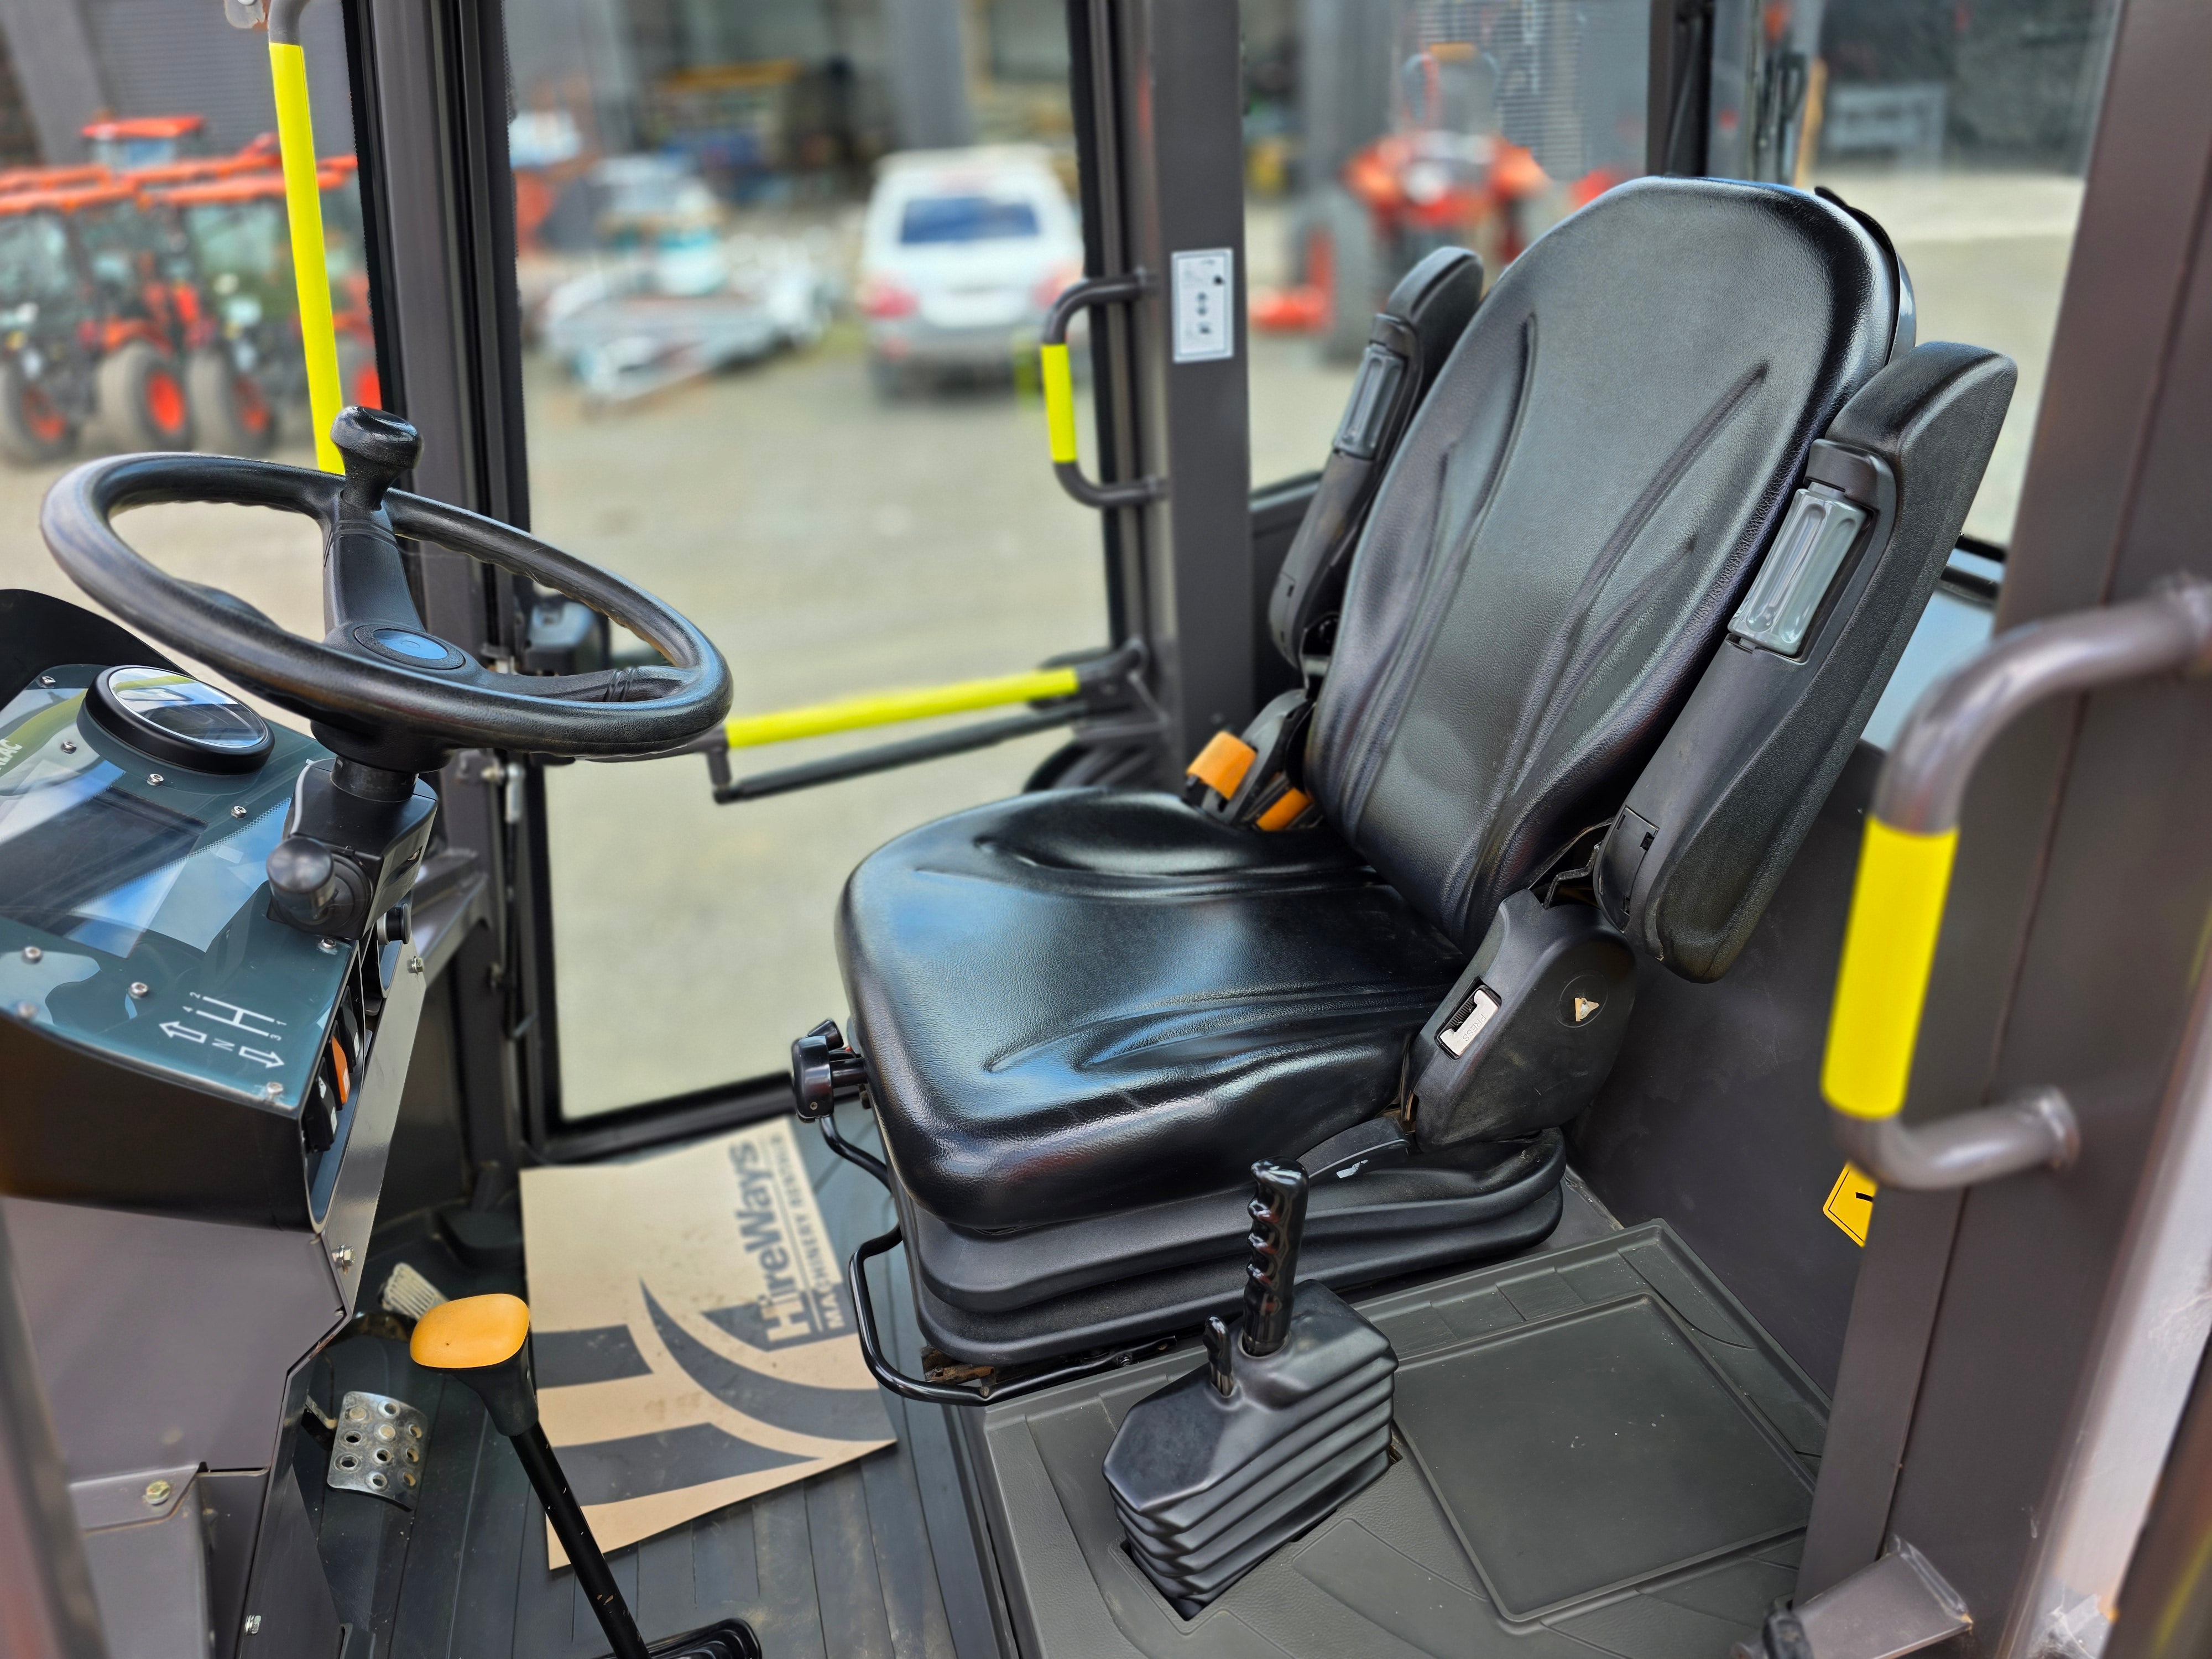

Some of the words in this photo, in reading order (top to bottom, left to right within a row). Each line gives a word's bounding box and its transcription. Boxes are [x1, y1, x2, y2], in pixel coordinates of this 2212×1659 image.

[1462, 1014, 1486, 1041] PRESS
[212, 1037, 235, 1051] N
[729, 1139, 812, 1342] HireWays
